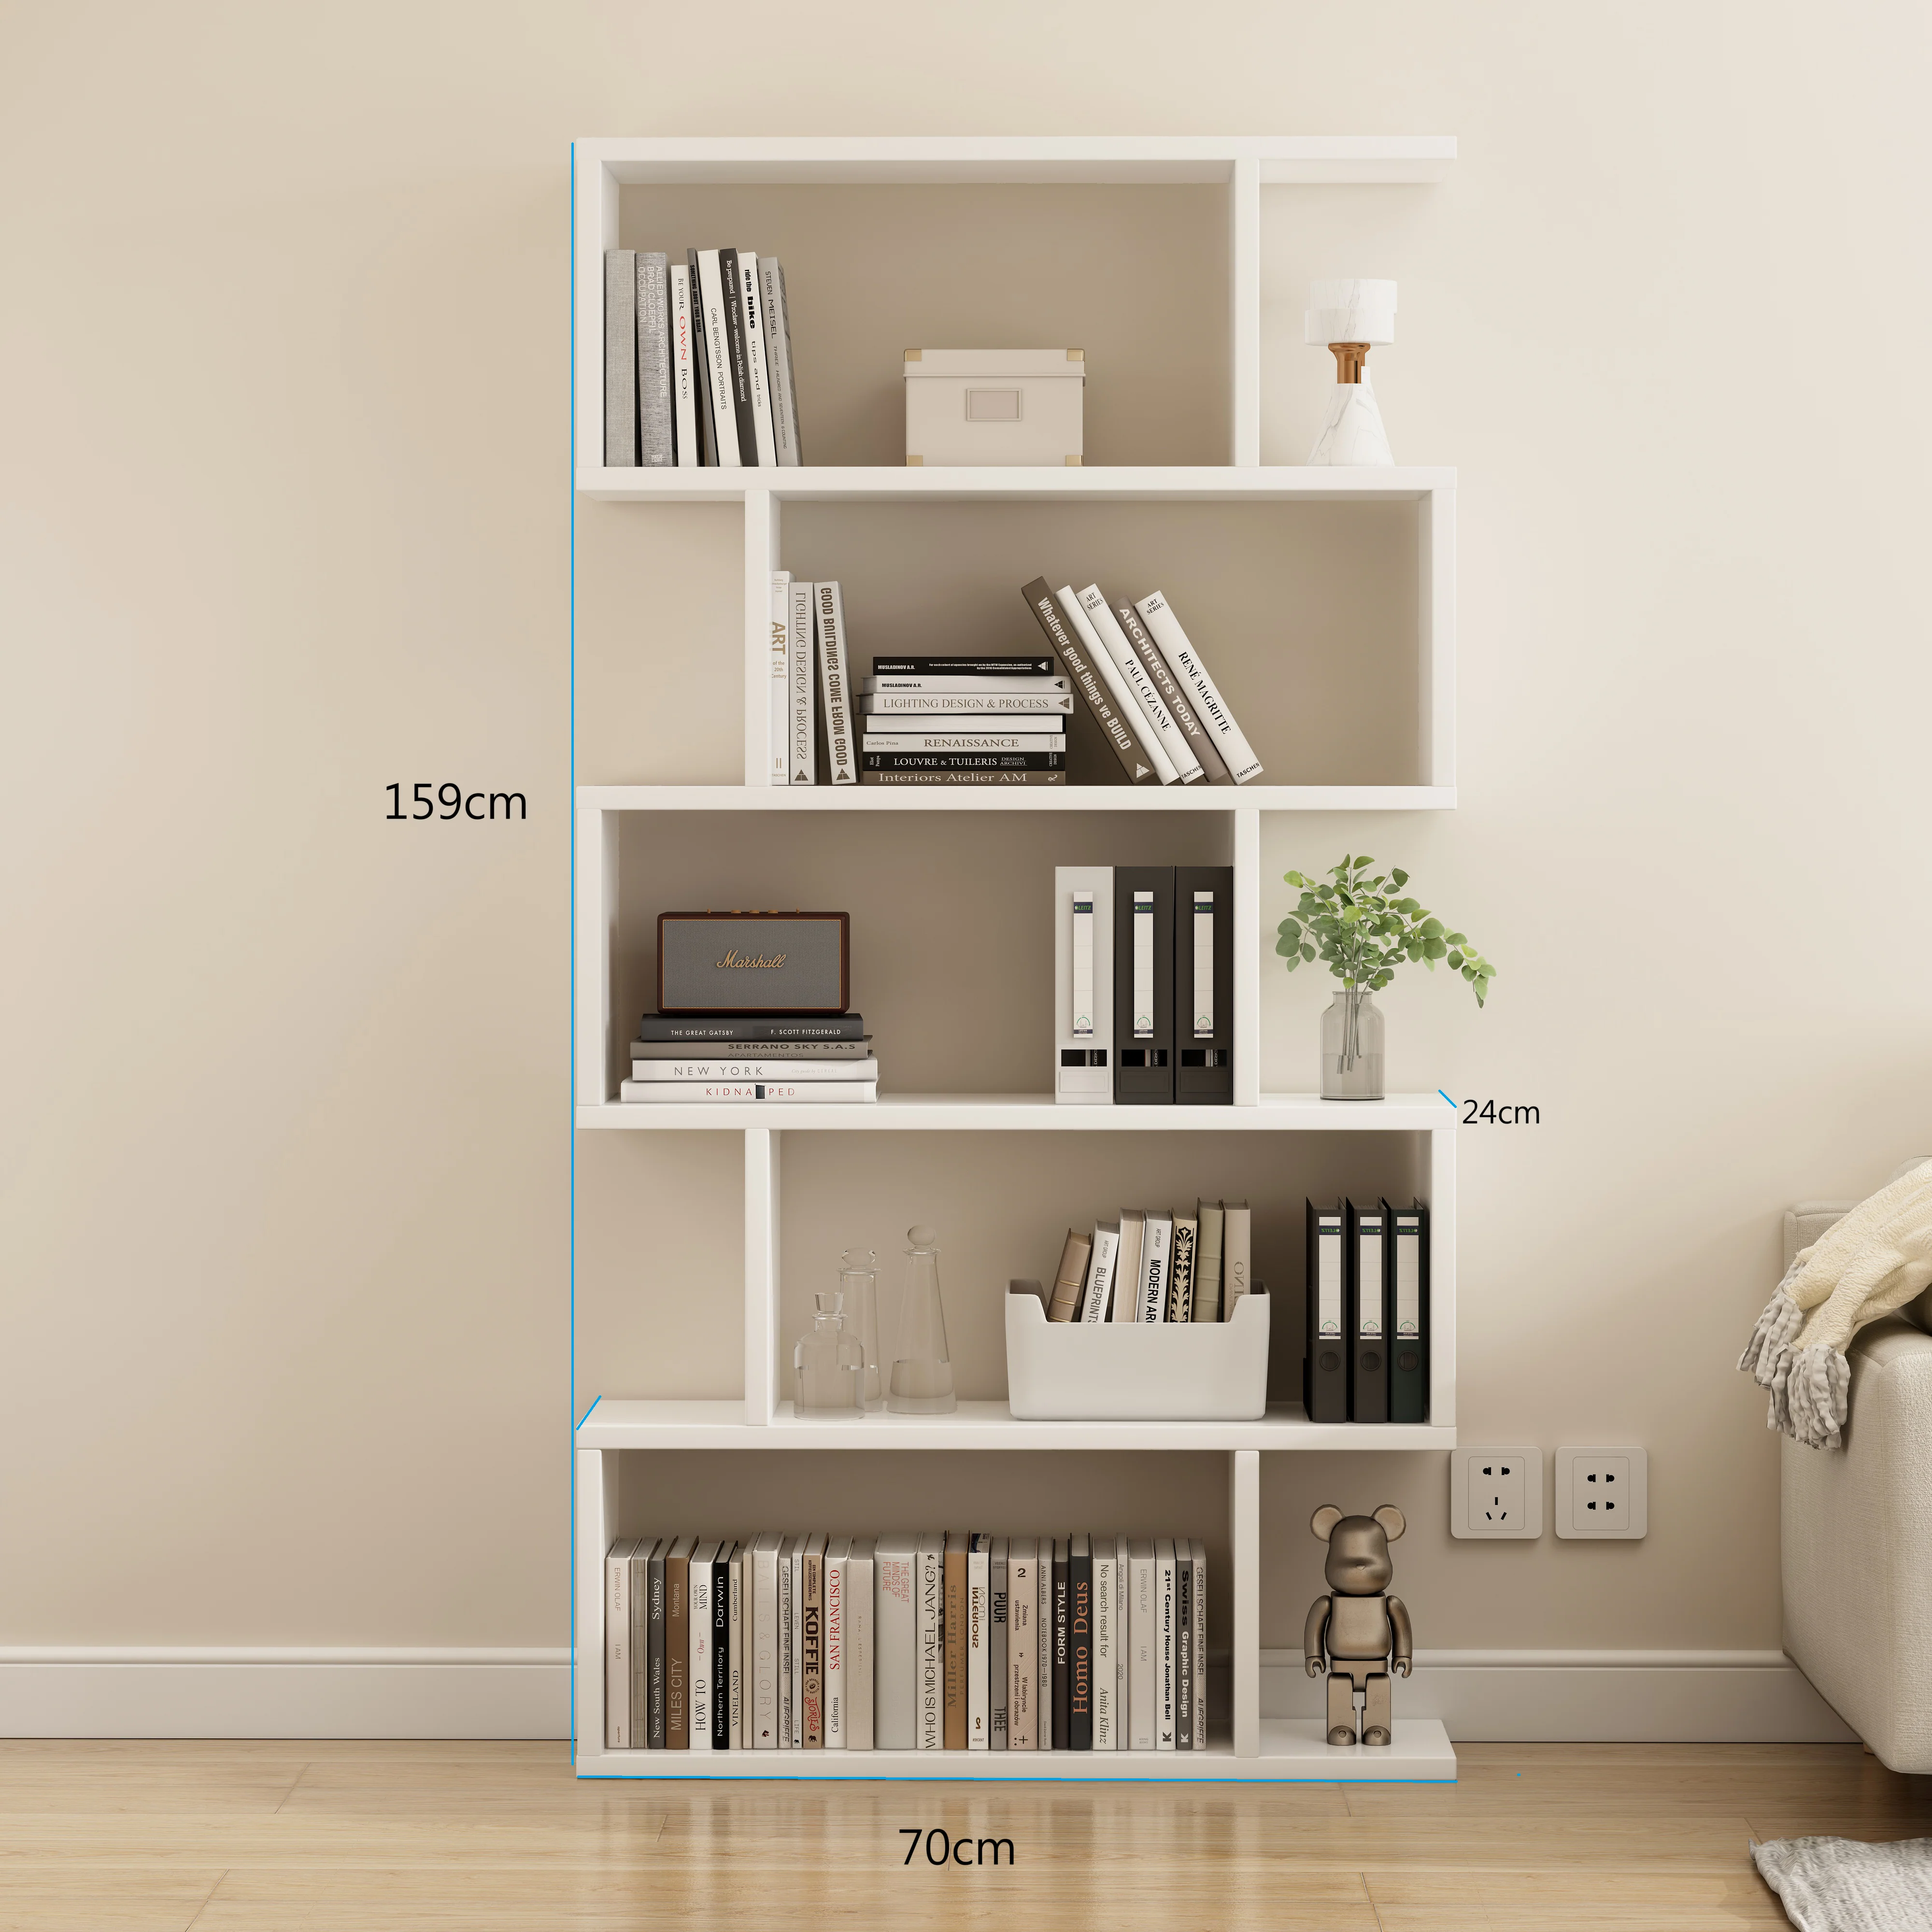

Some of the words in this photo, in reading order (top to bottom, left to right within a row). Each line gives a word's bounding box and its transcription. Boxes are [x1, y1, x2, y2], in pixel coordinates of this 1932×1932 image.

[726, 268, 735, 294] prepared
[768, 299, 777, 339] MEISEL
[713, 327, 722, 369] BENGTSSON
[718, 372, 727, 410] PORTRAITS
[1086, 592, 1096, 602] ART
[1087, 598, 1104, 611] SERIES
[1147, 602, 1164, 614] SERIES
[1148, 599, 1157, 608] ART
[772, 622, 785, 654] ART
[1038, 597, 1070, 646] Whatever
[1063, 647, 1087, 673] good
[1080, 671, 1103, 705] things
[1099, 704, 1111, 718] ve
[1107, 717, 1131, 750] BUILD
[1119, 609, 1175, 694] ARCHITECTS
[1172, 696, 1200, 736] TODAY
[883, 699, 938, 708] LIGHTING
[942, 699, 983, 708] DESIGN
[987, 699, 995, 708] &
[999, 699, 1049, 708] PROCESS
[1125, 659, 1143, 686] PAUL
[1141, 686, 1171, 731] CÉZANNE
[1178, 652, 1202, 680] RENÉ
[1194, 680, 1231, 734] MAGRITTE
[923, 739, 1019, 747] RENAISSANCE
[879, 773, 941, 781] Interiors
[946, 773, 994, 781] Atelier
[998, 773, 1027, 781] AM
[1181, 765, 1202, 779] TASCHEN
[1236, 762, 1260, 778] TASCHEN
[716, 950, 786, 968] Marshall
[674, 1066, 710, 1076] NEW
[720, 1066, 764, 1076] YORK
[1147, 1259, 1161, 1303] MODERN
[1100, 1564, 1109, 1577] No
[652, 1577, 661, 1619] Sydney
[699, 1584, 707, 1609] MIND
[829, 1569, 840, 1640] FRANCISCO
[924, 1565, 936, 1619] JANG?
[994, 1592, 1007, 1623] PUUR
[1057, 1581, 1065, 1623] STYLE
[1073, 1581, 1088, 1634] Deus
[1100, 1580, 1109, 1612] search
[1100, 1615, 1109, 1642] result
[1163, 1593, 1171, 1633] Century
[806, 1606, 819, 1675] KOFFIE
[1057, 1628, 1065, 1664] FORM
[1180, 1631, 1189, 1676] Graphic
[829, 1644, 840, 1670] SAN
[924, 1622, 936, 1693] MICHAEL
[671, 1658, 682, 1689] CITY
[695, 1679, 706, 1696] TO
[1073, 1646, 1088, 1714] Homo
[671, 1691, 682, 1731] MILES
[805, 1696, 820, 1732] STORIES
[925, 1696, 936, 1712] IS
[1100, 1687, 1108, 1714] Anita
[1180, 1679, 1189, 1718] Design
[695, 1700, 706, 1731] HOW
[925, 1714, 936, 1748] WHO
[994, 1706, 1006, 1732] THEE
[1099, 1716, 1108, 1745] Klinz
